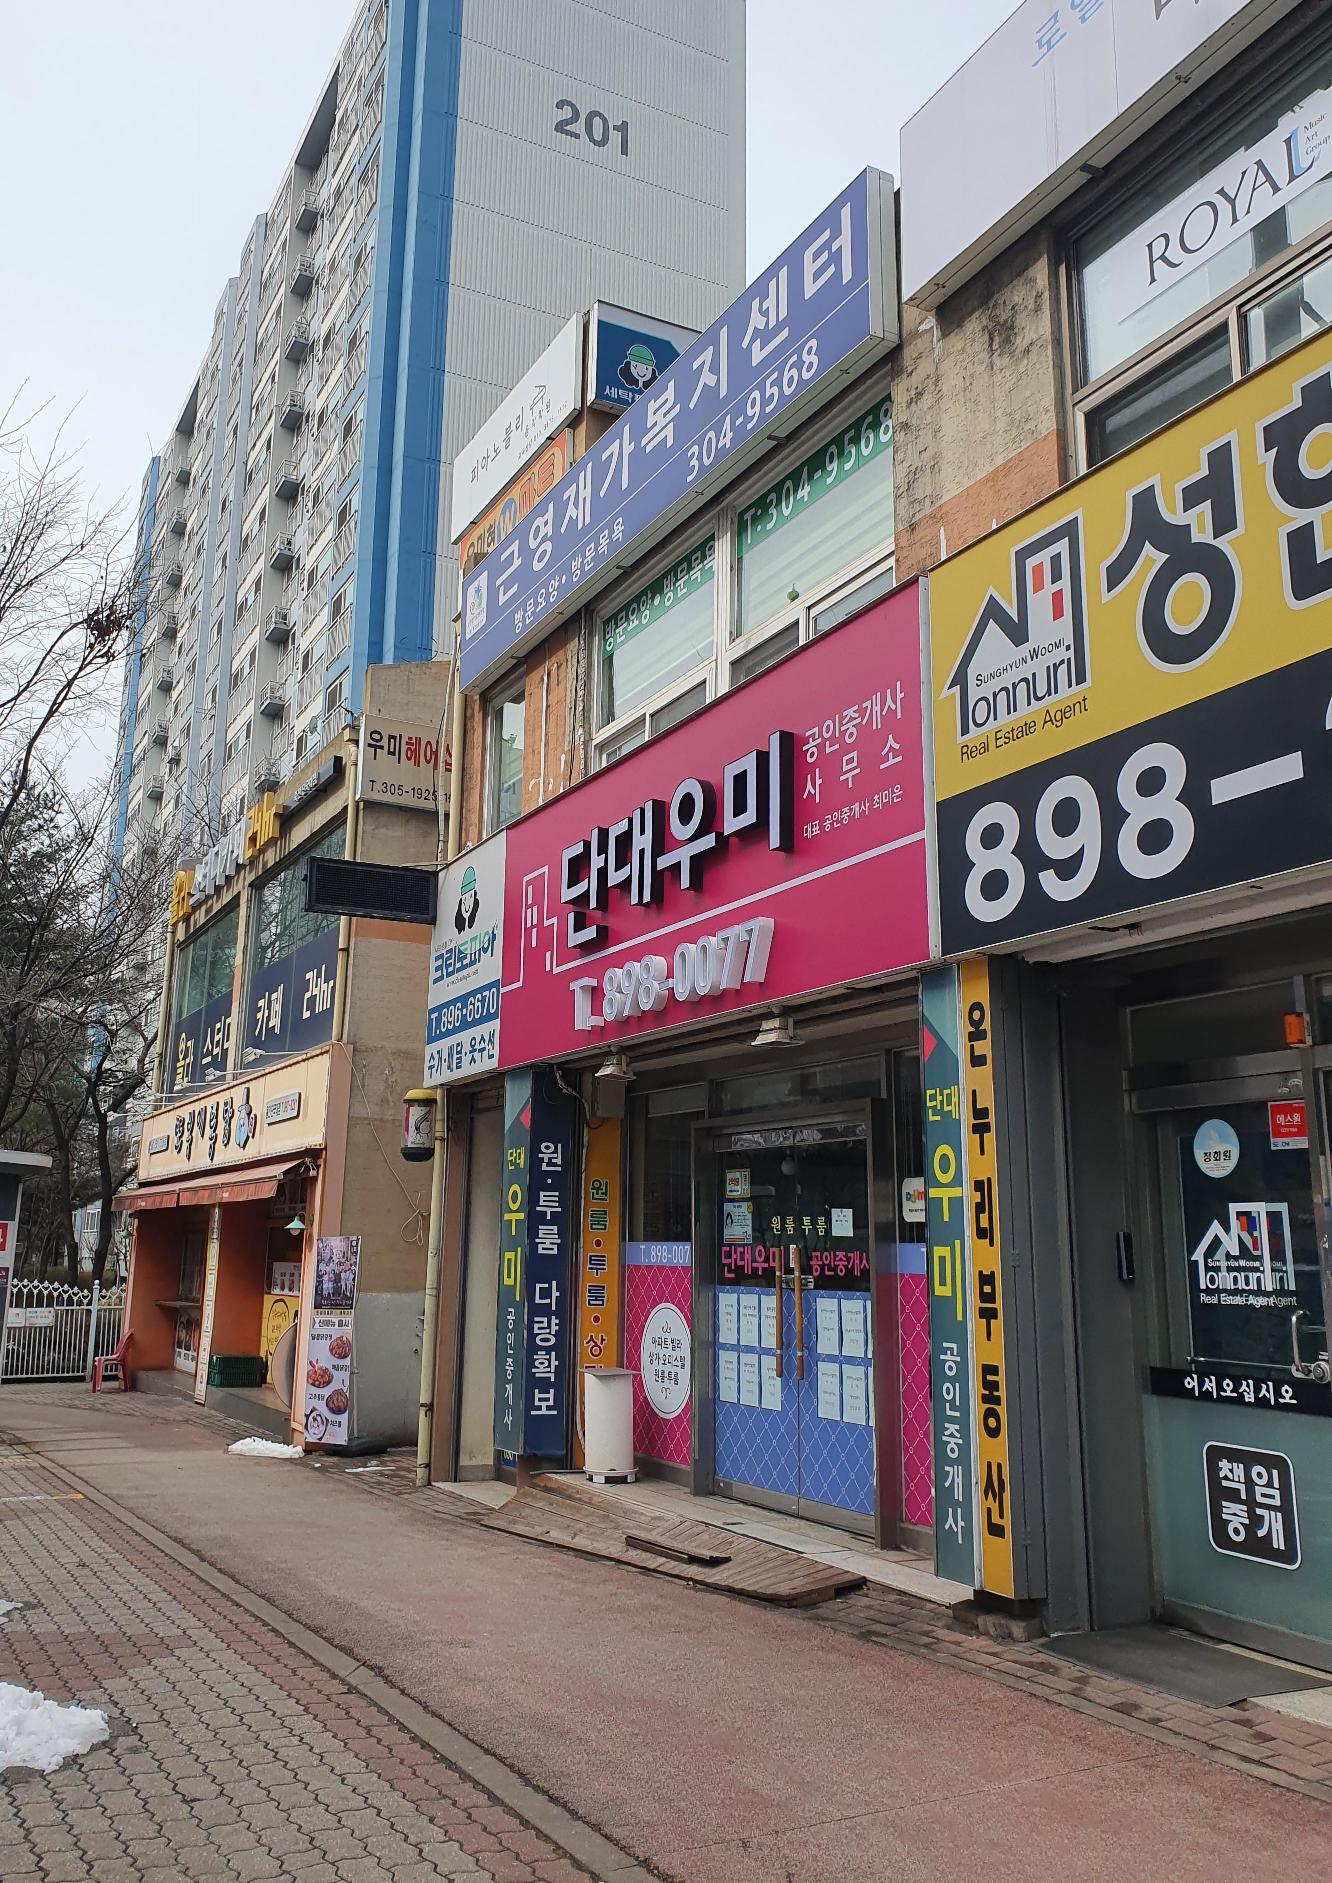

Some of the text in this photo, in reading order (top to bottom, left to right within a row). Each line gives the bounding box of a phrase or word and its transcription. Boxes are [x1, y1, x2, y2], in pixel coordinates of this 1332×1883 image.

[554, 98, 630, 157] 201
[1303, 112, 1328, 134] Music
[1304, 130, 1319, 145] Art
[1305, 134, 1331, 156] Group
[1143, 125, 1322, 287] ROYAL
[495, 201, 853, 606] 근영재가복지센터
[603, 384, 641, 403] 세탁
[686, 338, 820, 483] 304-9568
[975, 655, 1028, 688] SUNGHYUN
[802, 680, 905, 764] 공인중개사
[960, 695, 1089, 764] Real Estate Agent
[803, 784, 904, 839] 대표 공인중개사 최미은
[964, 695, 1332, 923] 898-
[560, 729, 795, 949] 단대우미
[432, 927, 497, 986] 크린토피아
[569, 916, 775, 1031] T.898-0077
[254, 983, 284, 1041] 카페
[302, 963, 334, 1020] 24hr
[430, 987, 497, 1037] T.896-6670
[1276, 1112, 1302, 1126] 에스원
[507, 1146, 525, 1171] 단대
[1203, 1149, 1232, 1162] 정회원
[503, 1183, 525, 1302] 우미
[721, 1244, 785, 1278] 단대우미
[967, 1000, 1006, 1541] 온누리부동산
[925, 1085, 965, 1546] 단대 우미 공인중개사
[1200, 1293, 1219, 1305] Real
[502, 1307, 517, 1432] 공인중개사
[530, 1280, 561, 1417] 다량확보
[1183, 1374, 1298, 1407] 어서오십시오
[1218, 1456, 1282, 1505] 책임
[1219, 1500, 1287, 1552] 중개
